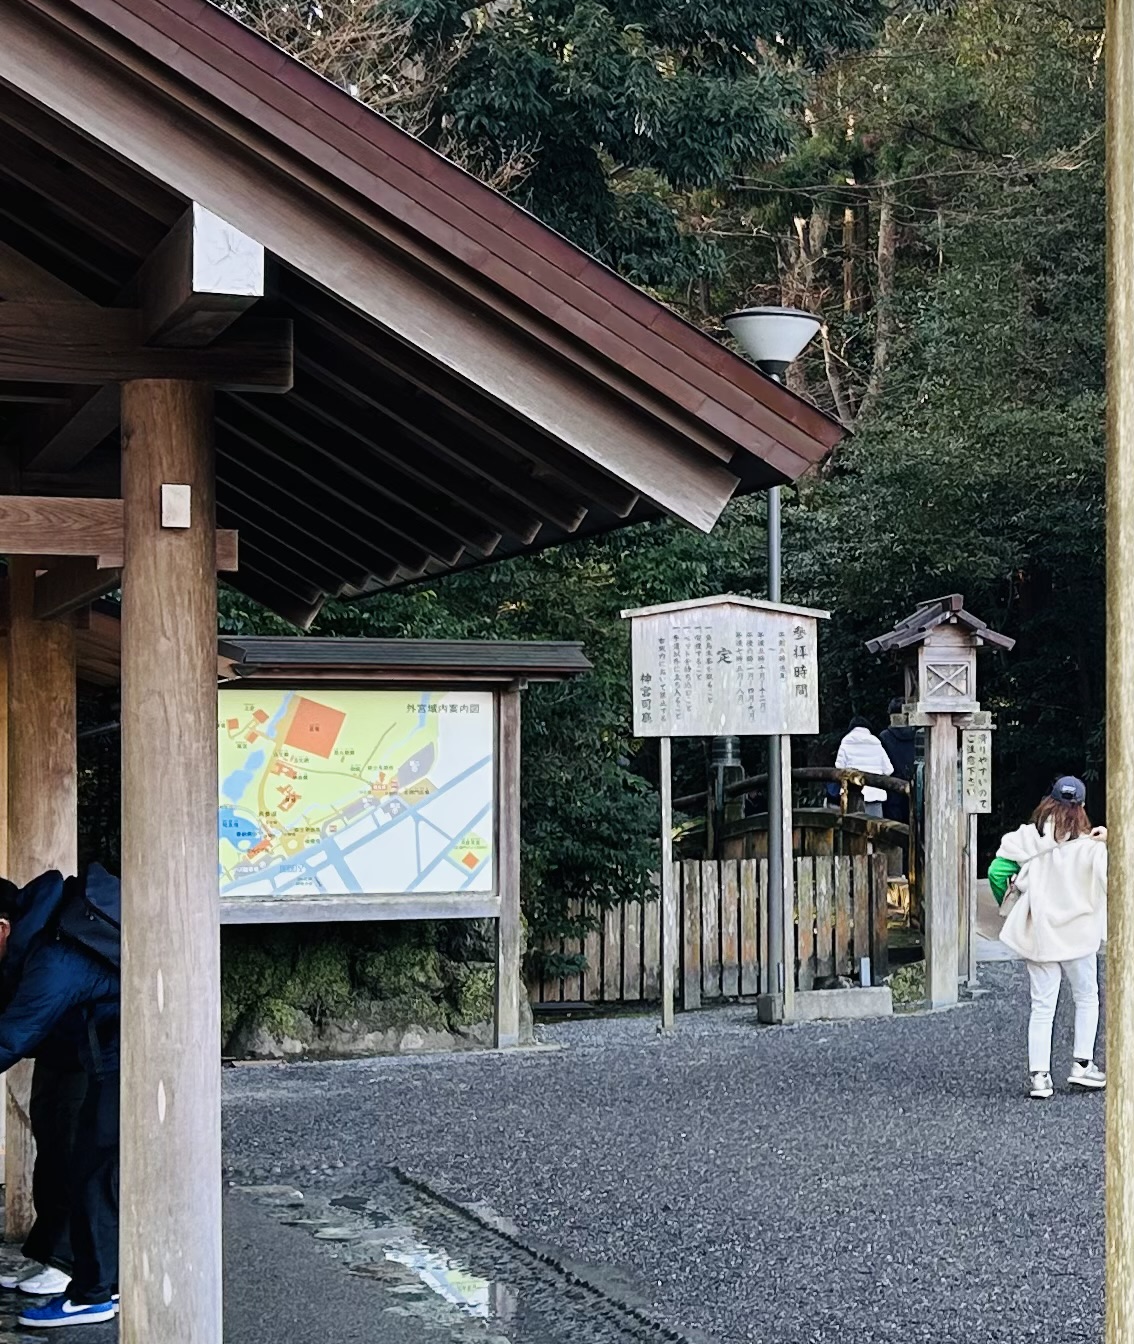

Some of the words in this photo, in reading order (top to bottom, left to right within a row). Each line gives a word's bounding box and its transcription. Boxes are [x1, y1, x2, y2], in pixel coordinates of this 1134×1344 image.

[717, 647, 733, 664] 定
[406, 703, 480, 714] 外宮域内案内図
